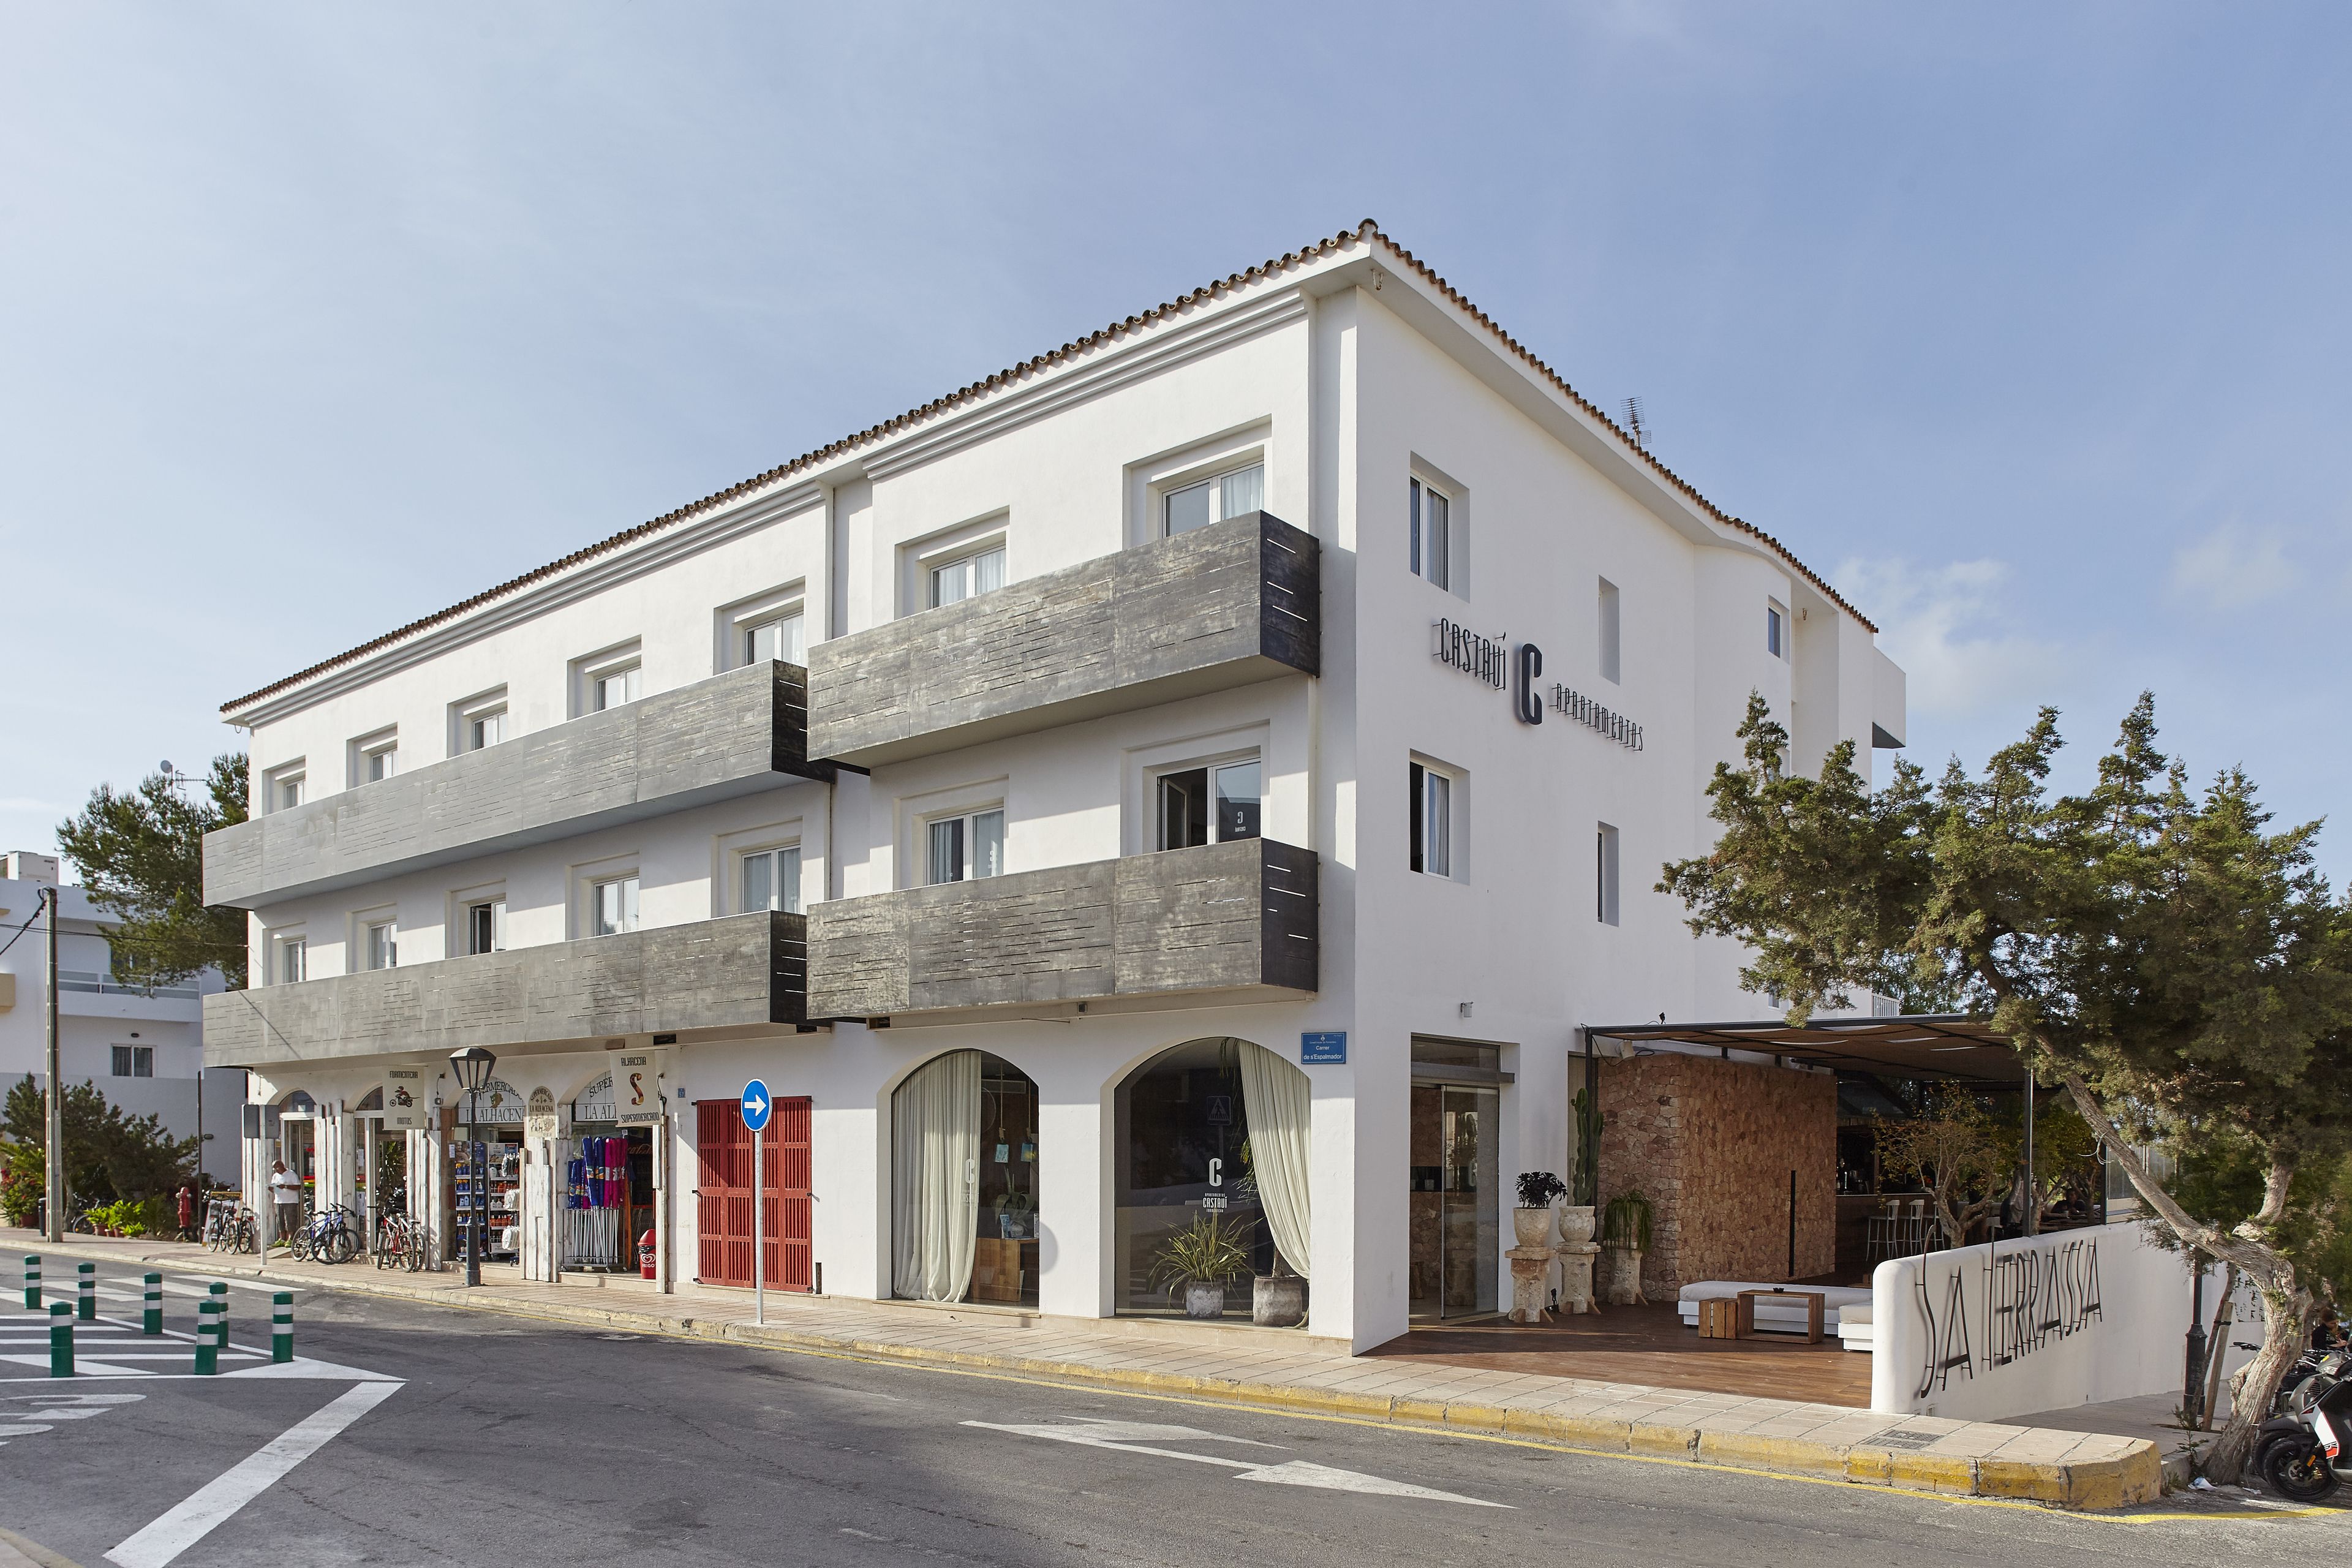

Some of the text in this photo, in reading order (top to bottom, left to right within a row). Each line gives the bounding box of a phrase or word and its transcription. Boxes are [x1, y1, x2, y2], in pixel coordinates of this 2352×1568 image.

[1521, 643, 1543, 725] C
[1556, 683, 1643, 752] APARTAMENTOS
[620, 1056, 647, 1067] ALHACENA
[389, 1070, 418, 1079] FORMENTERA
[585, 1105, 598, 1120] LA
[620, 1112, 660, 1123] SUPERMERCADO
[1209, 1158, 1222, 1187] C
[1920, 1216, 2102, 1399] SA TERRASSA
